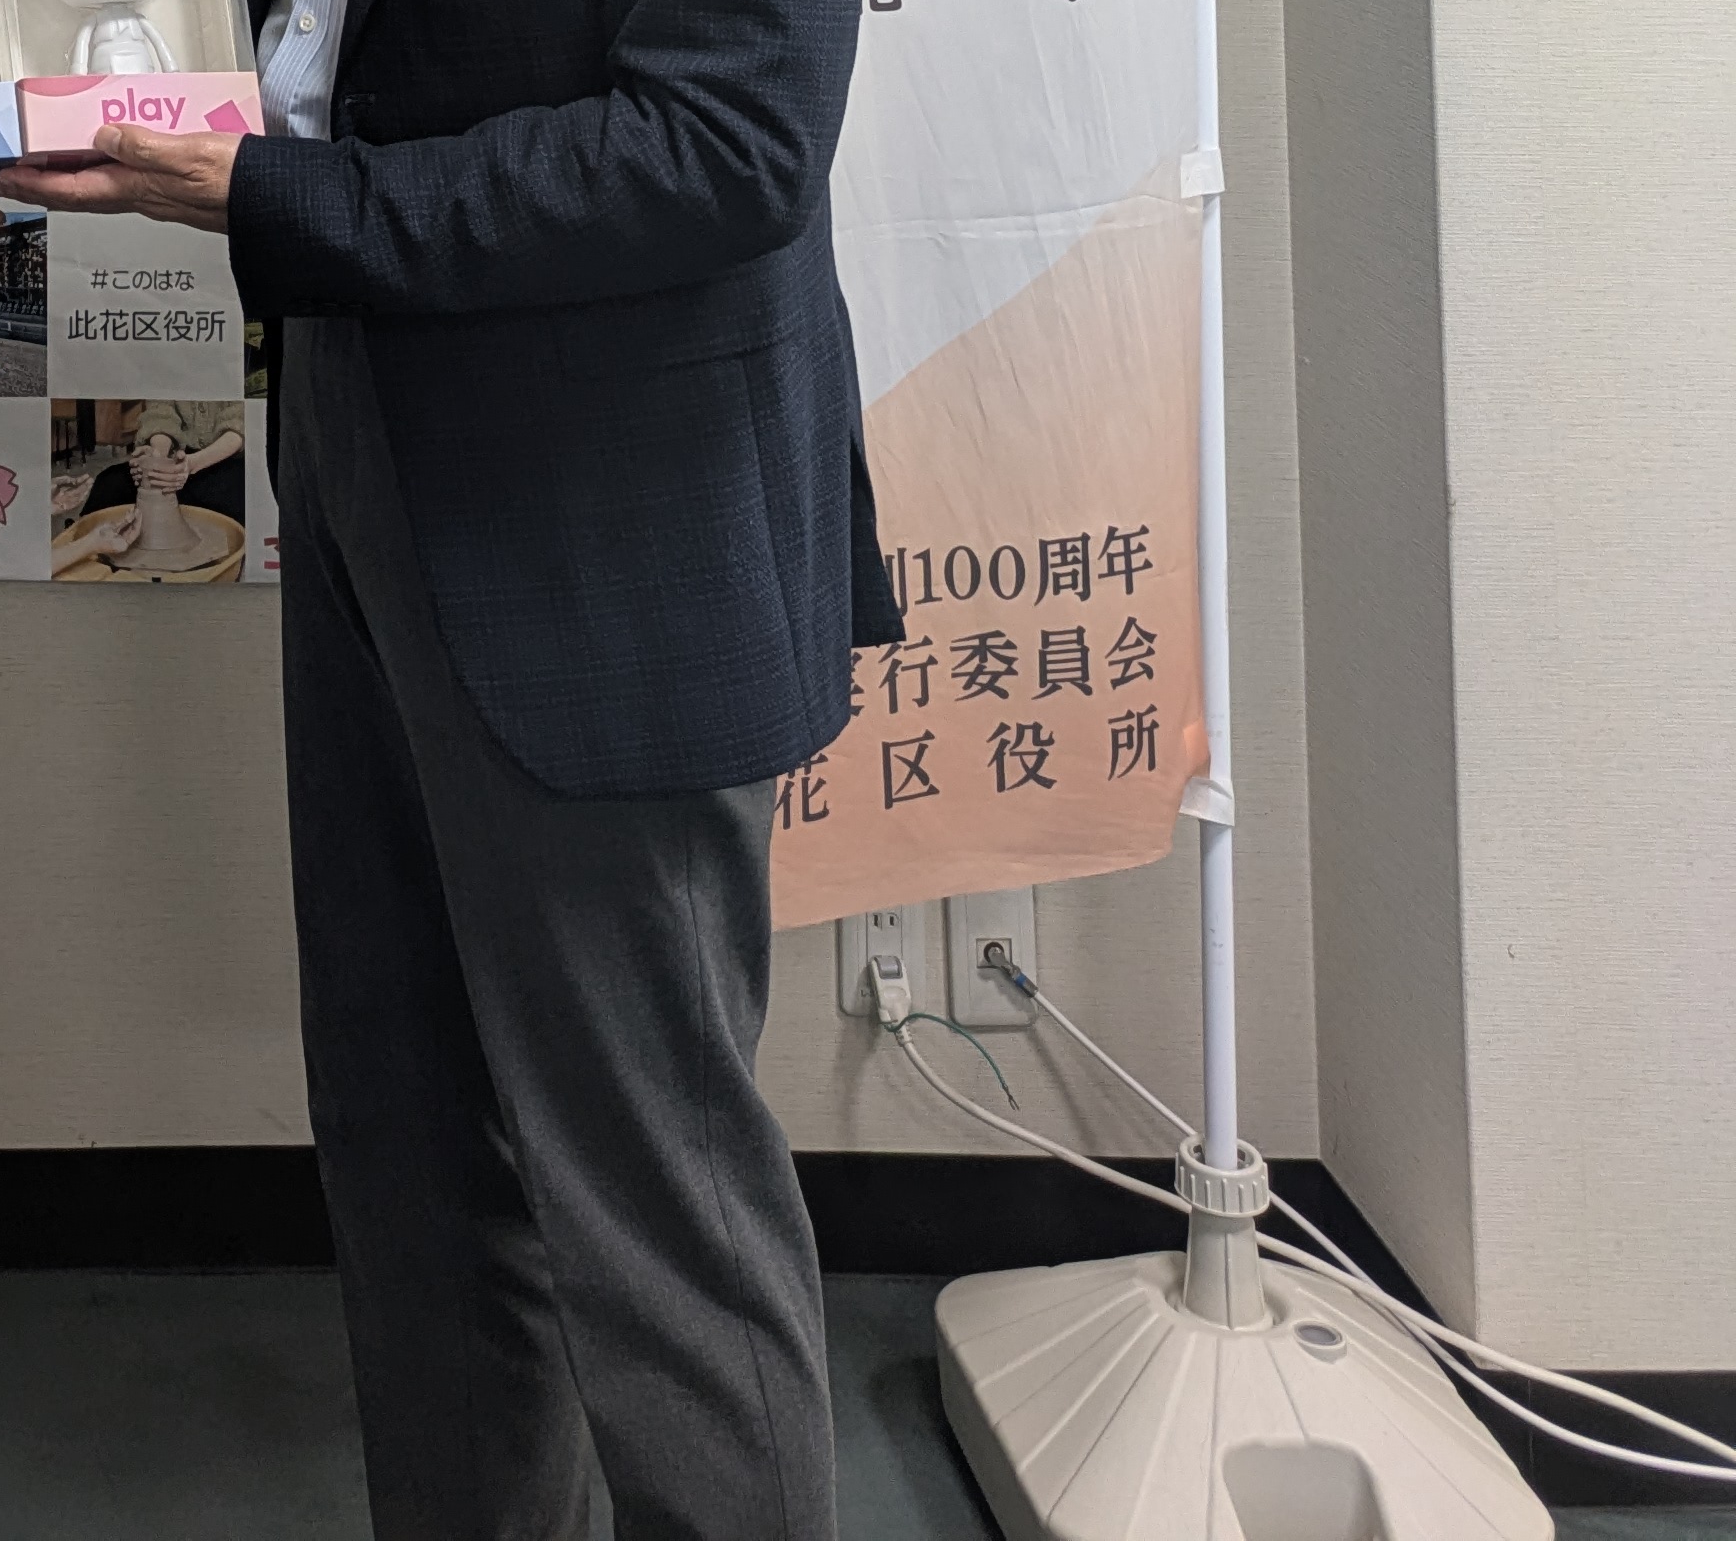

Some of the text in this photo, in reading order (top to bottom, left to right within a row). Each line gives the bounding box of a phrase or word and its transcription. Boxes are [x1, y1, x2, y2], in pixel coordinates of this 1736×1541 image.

[101, 87, 187, 130] play
[90, 268, 195, 292] #このはな
[68, 309, 227, 344] 此花区役所
[850, 616, 1158, 717] 行委員会
